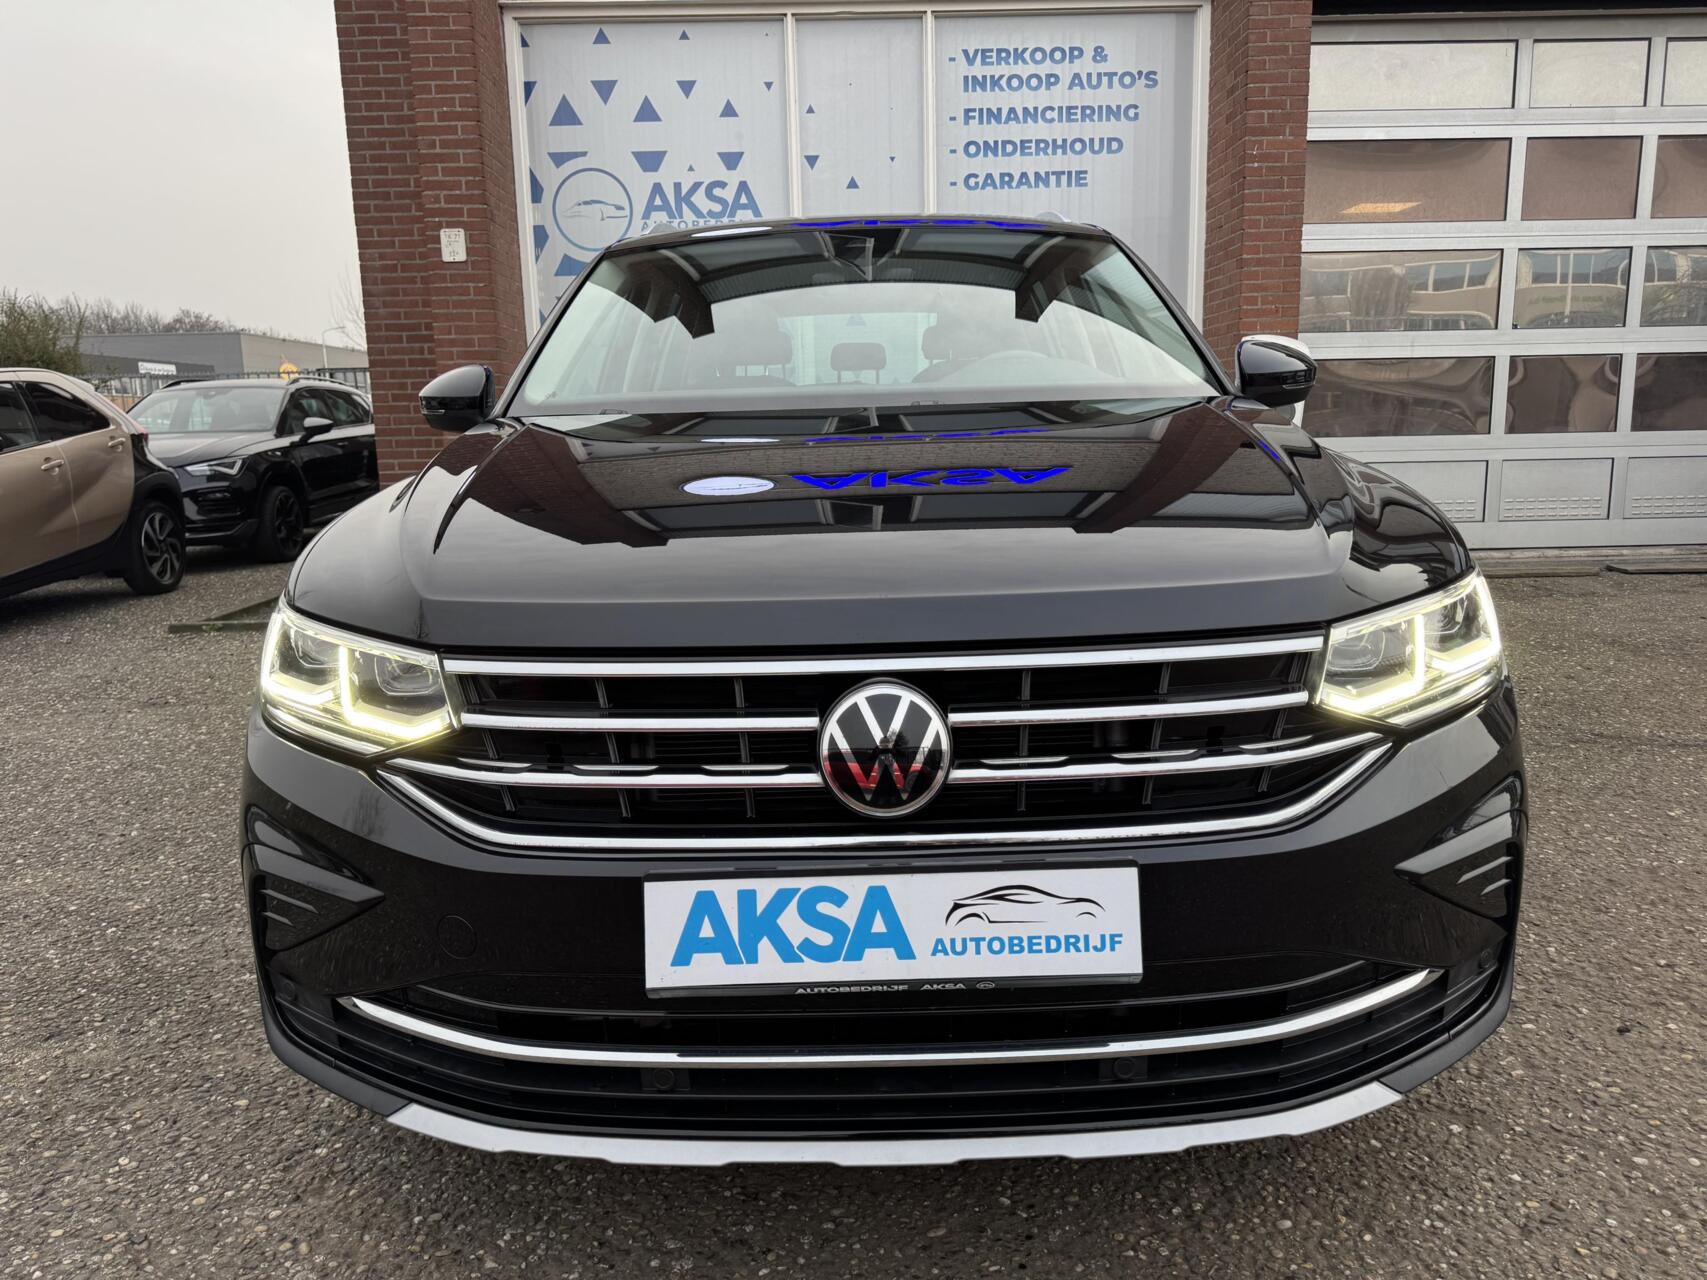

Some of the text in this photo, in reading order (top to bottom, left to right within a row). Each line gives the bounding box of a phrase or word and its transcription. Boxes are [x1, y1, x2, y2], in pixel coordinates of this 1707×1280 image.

[961, 46, 1085, 67] VERKOOP
[1091, 45, 1108, 64] &
[962, 73, 1061, 93] INKOOP
[963, 104, 1140, 126] FINANCIERING
[963, 137, 1124, 159] ONDERHOUD
[963, 170, 1089, 191] GARANTIE
[641, 179, 763, 220] AKSA
[670, 885, 917, 967] AKSA
[930, 933, 1124, 957] AUTOBEDRIJF
[794, 983, 967, 995] AUTOBEDRIJF AKSA
